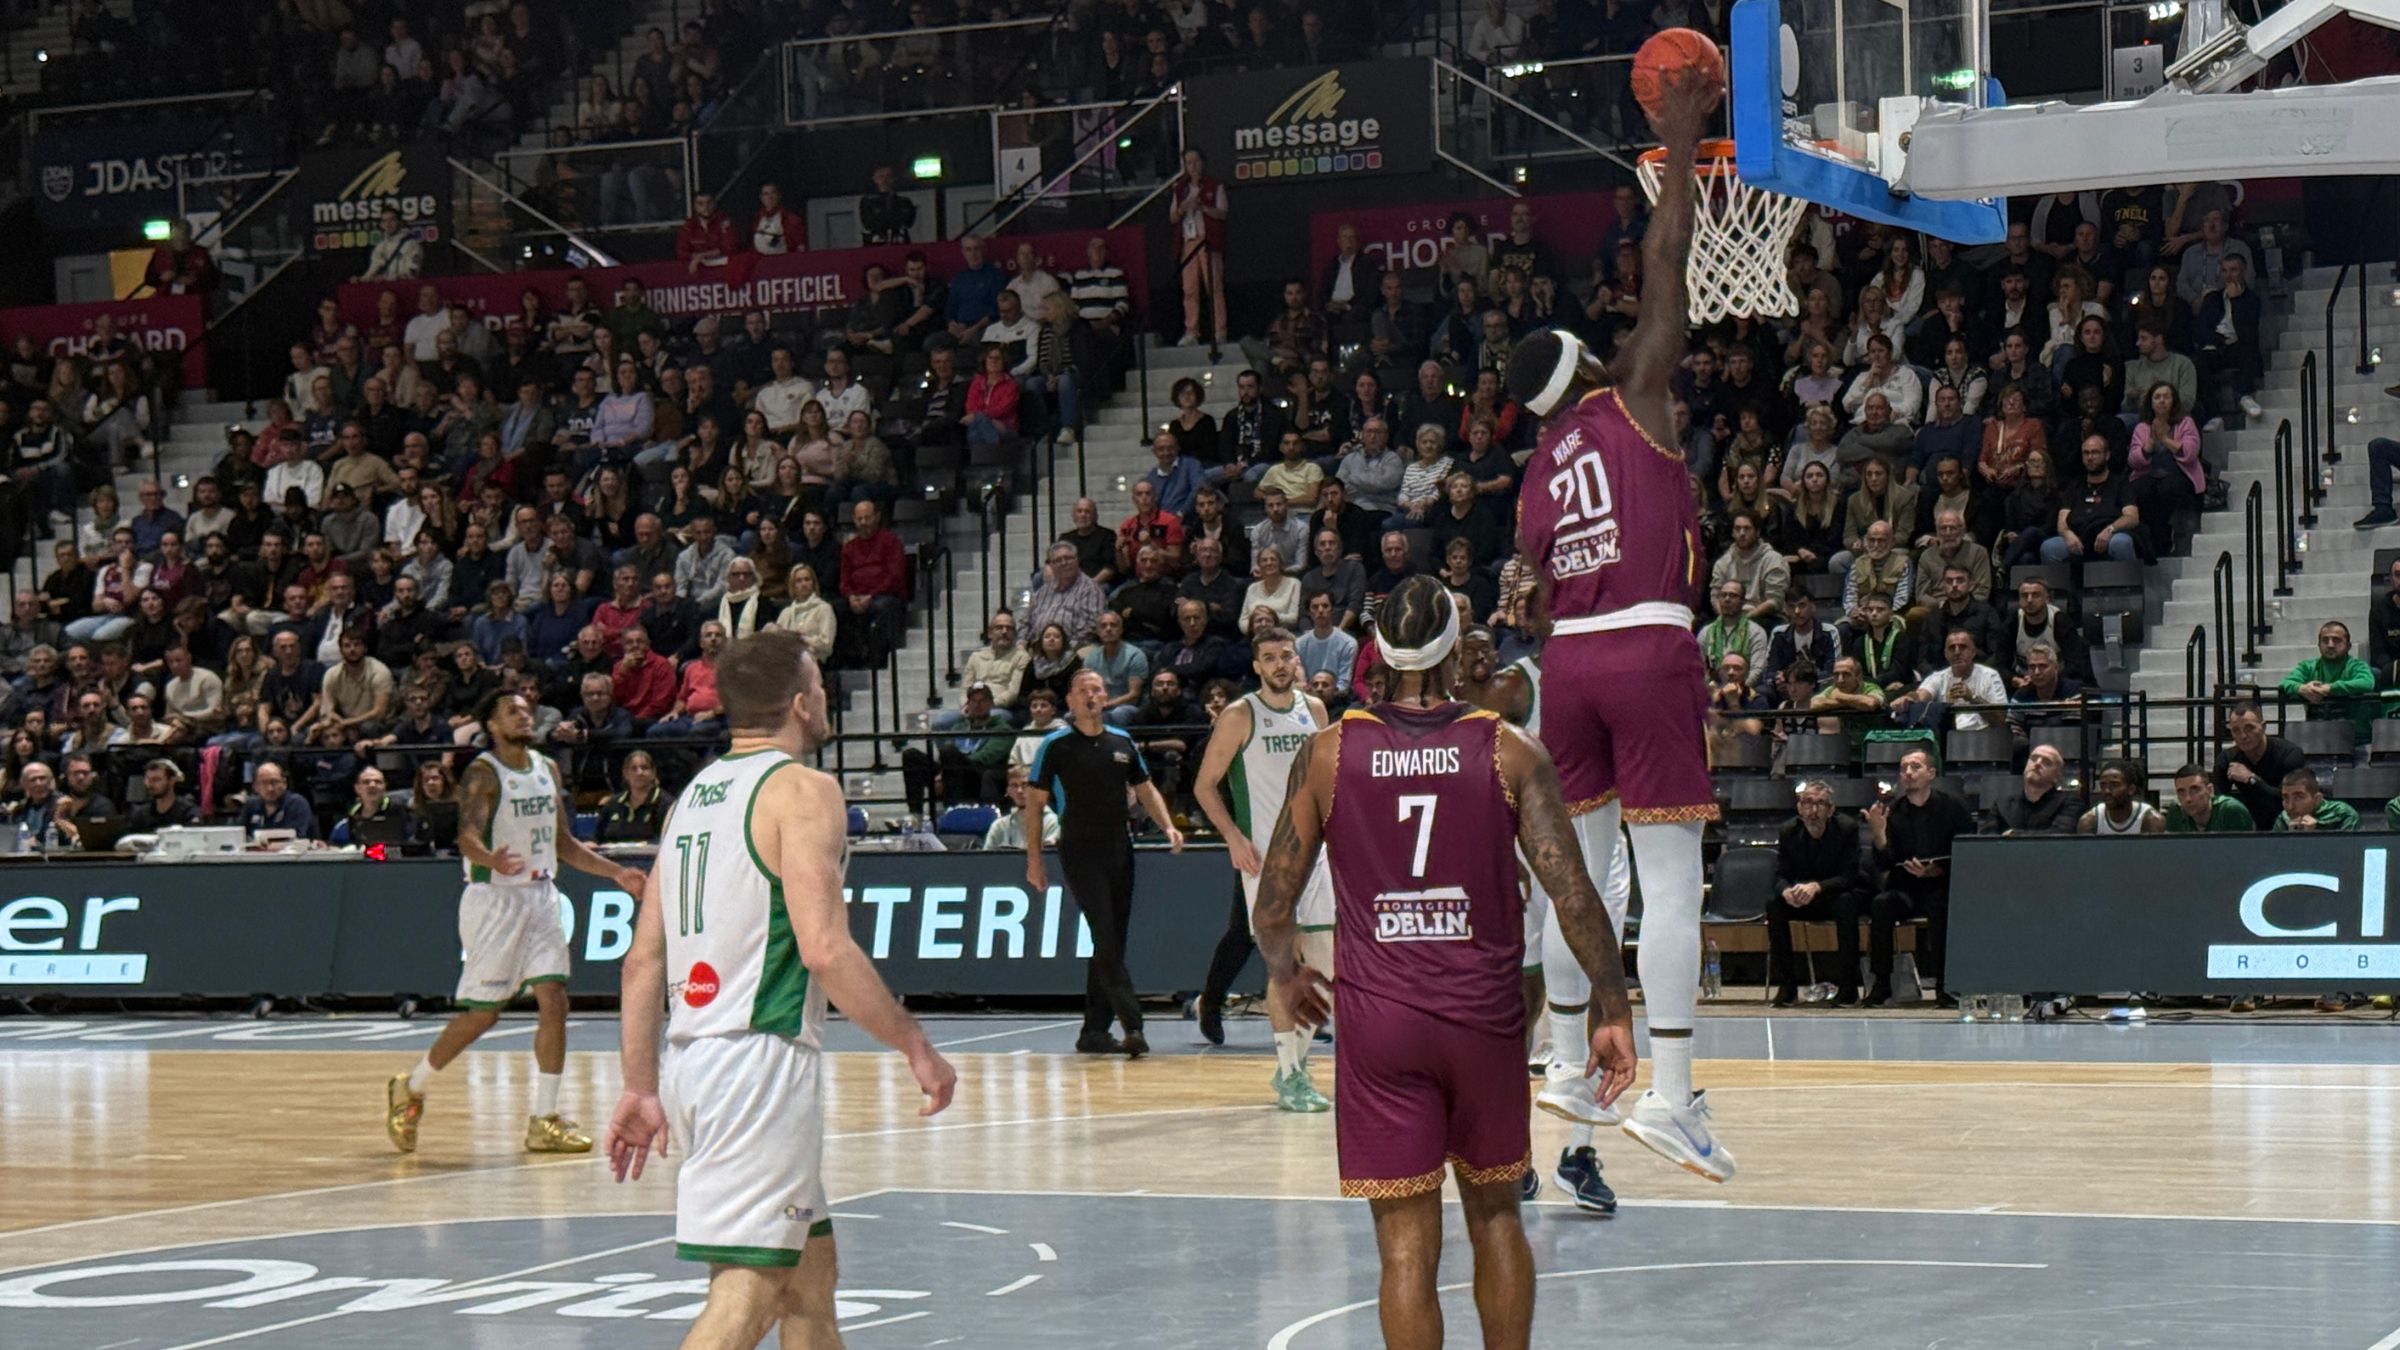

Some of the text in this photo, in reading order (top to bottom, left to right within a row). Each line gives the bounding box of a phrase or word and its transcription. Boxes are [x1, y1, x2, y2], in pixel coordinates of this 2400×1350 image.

[2133, 57, 2143, 73] 3
[1235, 117, 1381, 151] message
[1016, 157, 1025, 173] 4
[1273, 147, 1342, 159] FACTORY
[757, 274, 847, 305] OFFICIEL
[1552, 428, 1584, 466] WARE
[1549, 451, 1613, 532] 20
[1552, 537, 1617, 574] DELIN
[1372, 747, 1460, 777] EDWARDS
[1398, 795, 1438, 877] 7
[676, 831, 712, 936] 11
[1374, 901, 1471, 912] FROMAGERIE
[1378, 912, 1468, 937] DELIN
